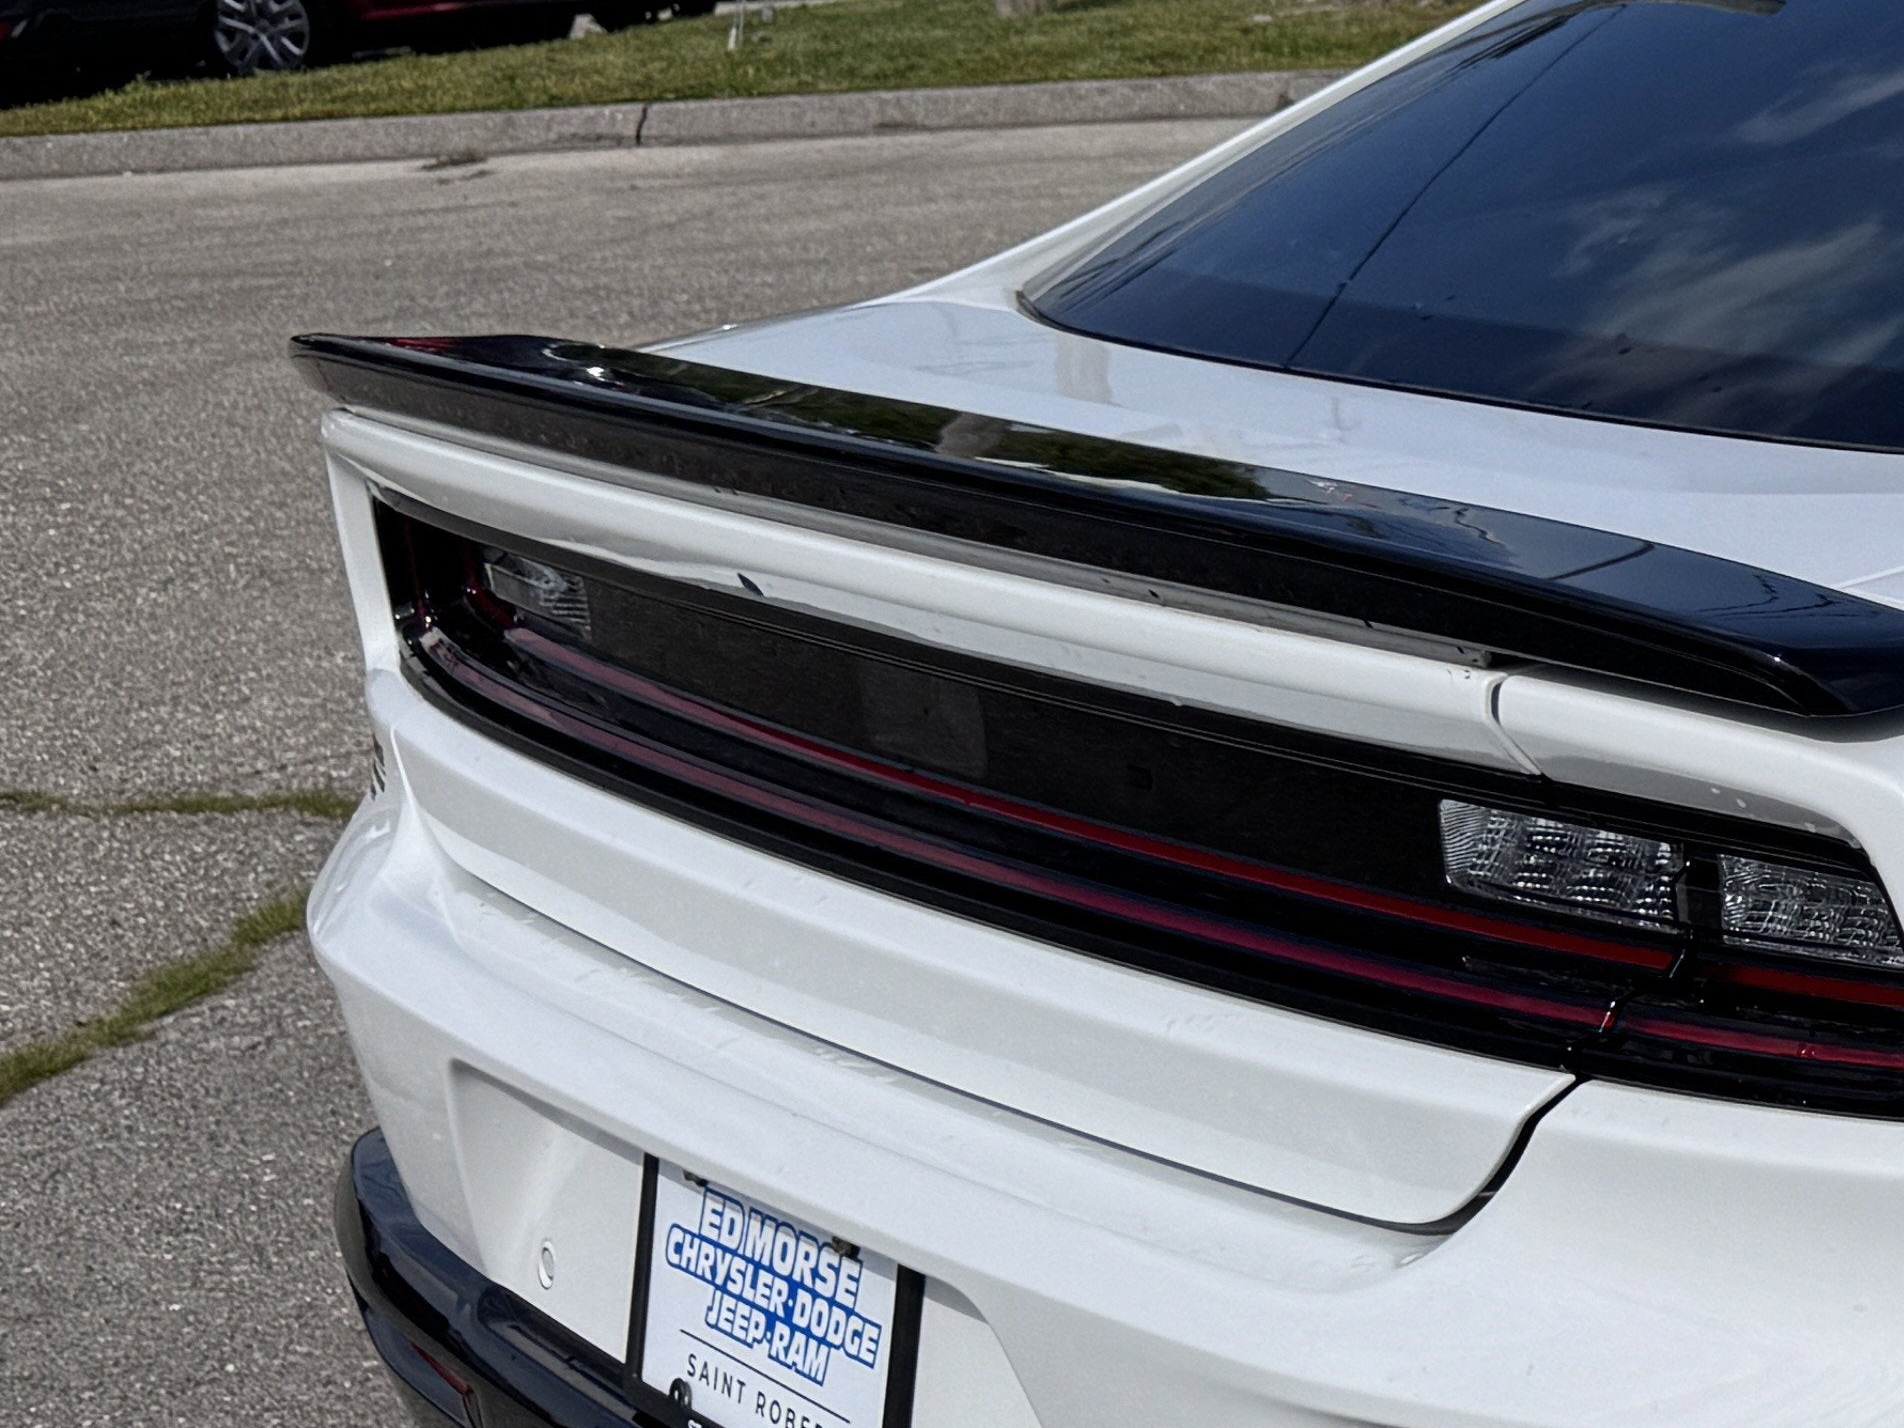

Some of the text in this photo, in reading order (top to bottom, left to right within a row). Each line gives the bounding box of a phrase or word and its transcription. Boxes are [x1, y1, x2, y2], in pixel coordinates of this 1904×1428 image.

[700, 1190, 862, 1310] ED MORSE
[686, 1352, 747, 1404] SAINT
